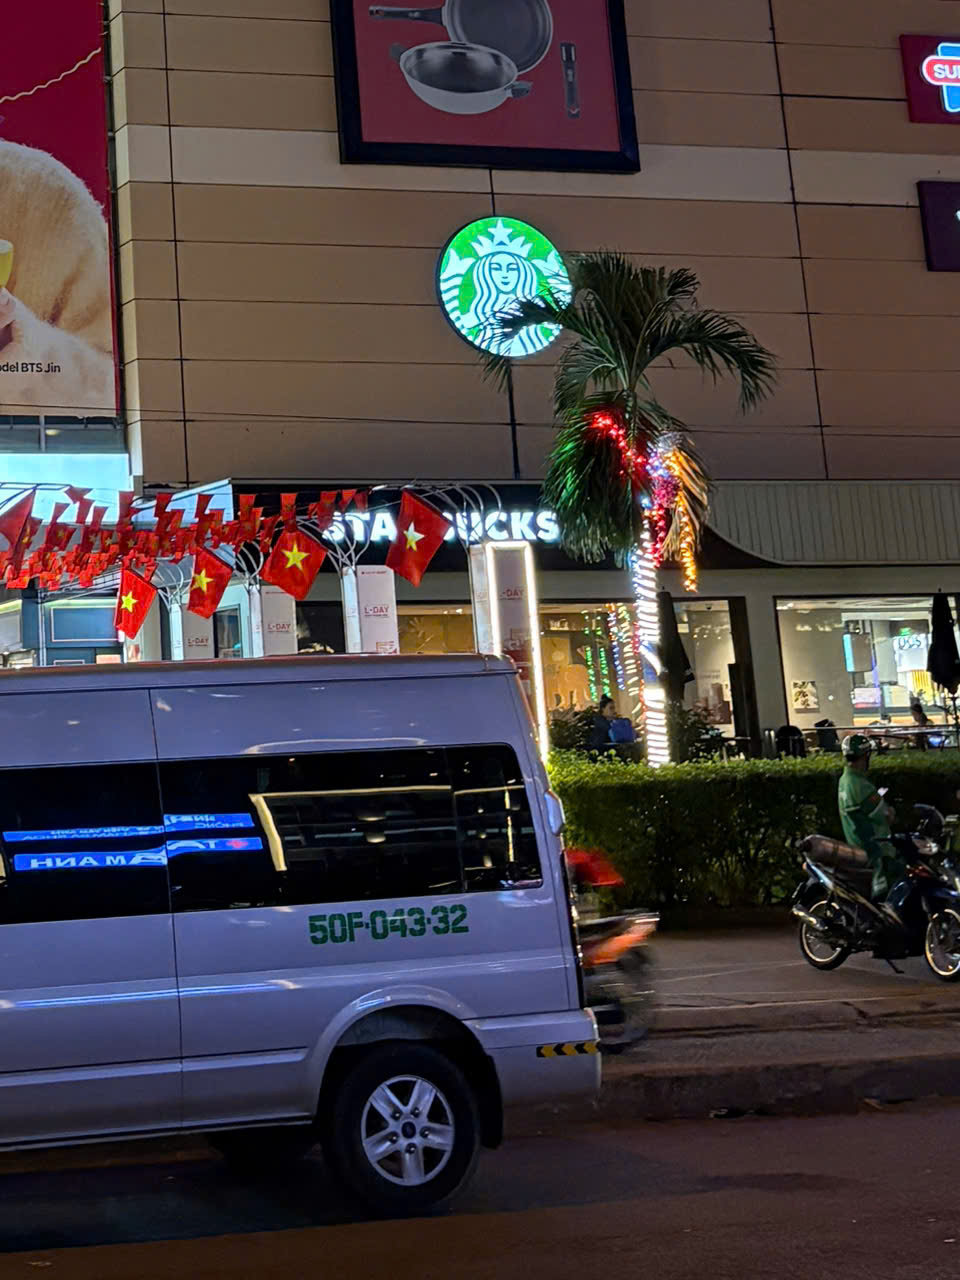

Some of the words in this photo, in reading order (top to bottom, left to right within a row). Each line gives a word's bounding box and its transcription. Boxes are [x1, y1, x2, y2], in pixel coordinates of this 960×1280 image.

[21, 362, 43, 373] BTS
[44, 362, 61, 373] Jin
[322, 511, 560, 543] STAUCKS
